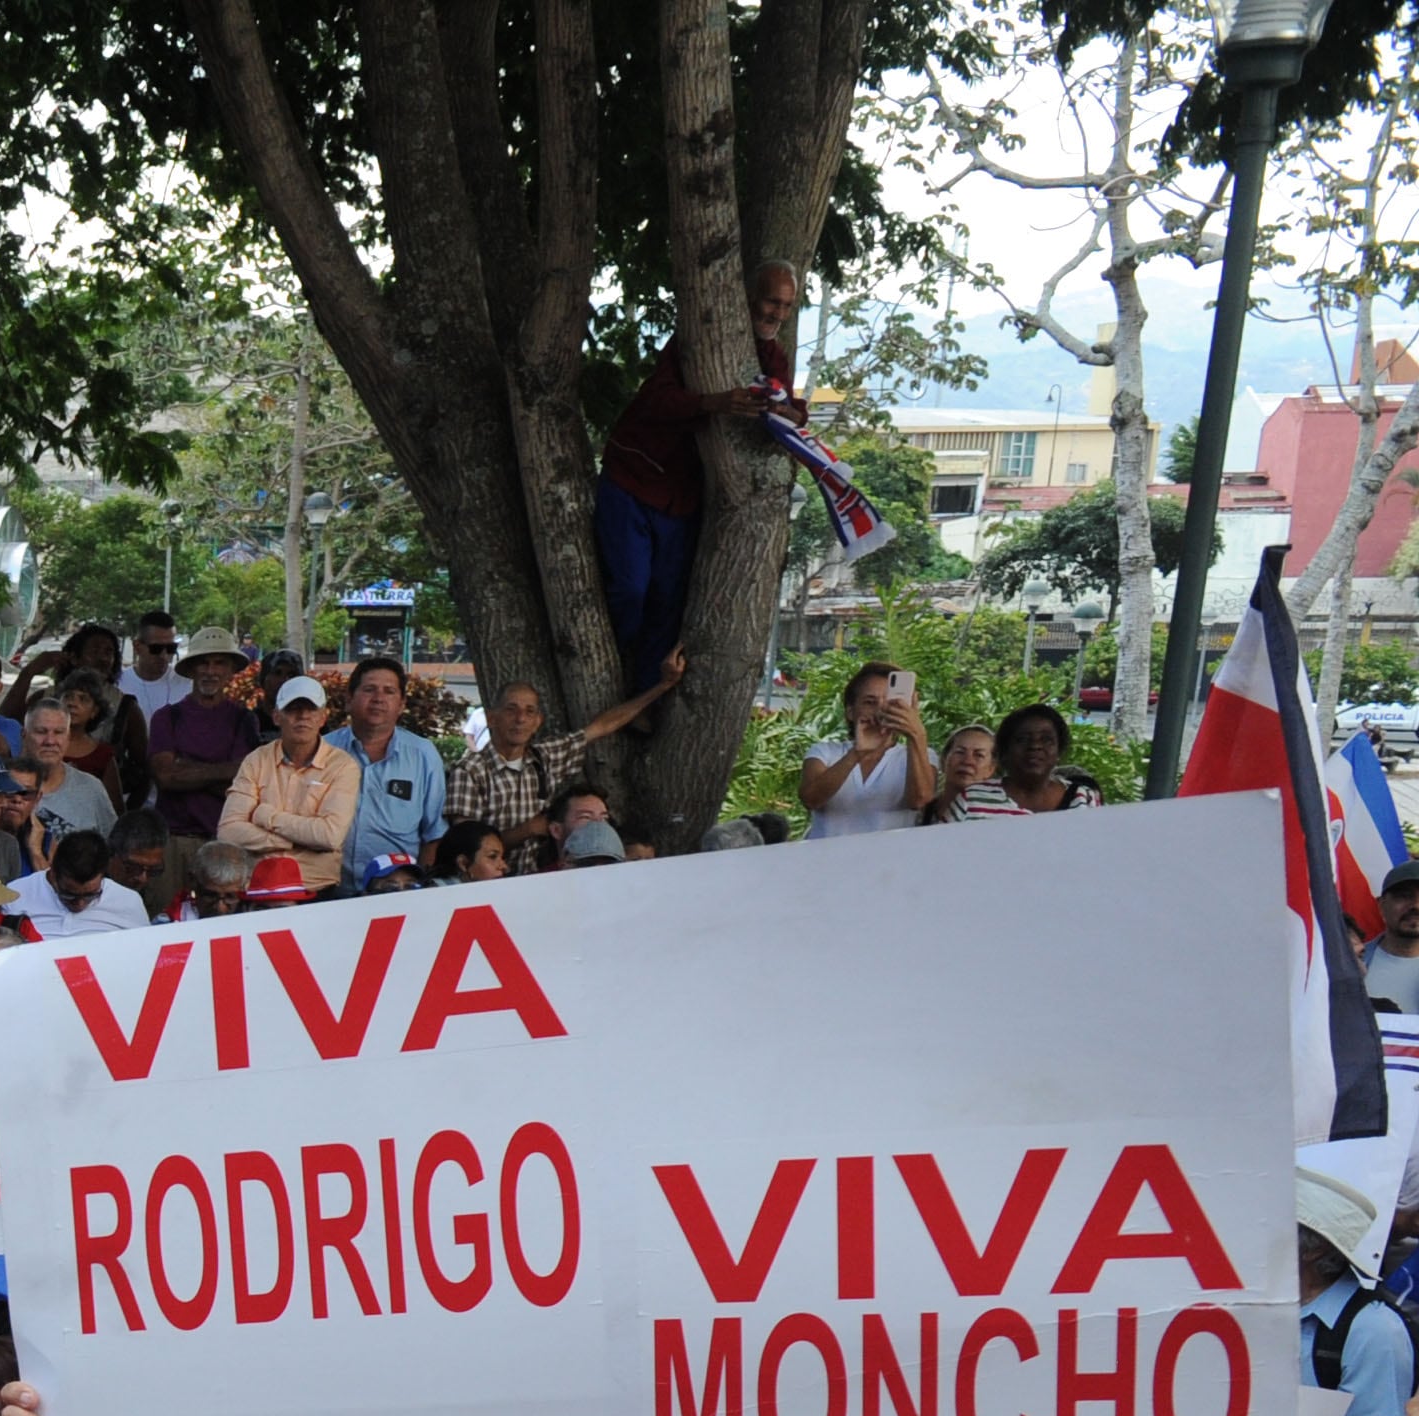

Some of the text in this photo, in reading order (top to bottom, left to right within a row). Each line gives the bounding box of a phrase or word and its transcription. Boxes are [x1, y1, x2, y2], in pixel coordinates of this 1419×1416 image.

[1355, 712, 1404, 721] POLICIA
[54, 903, 568, 1082] VIVA
[70, 1121, 580, 1334] RODRIGO
[652, 1144, 1244, 1303] VIVA
